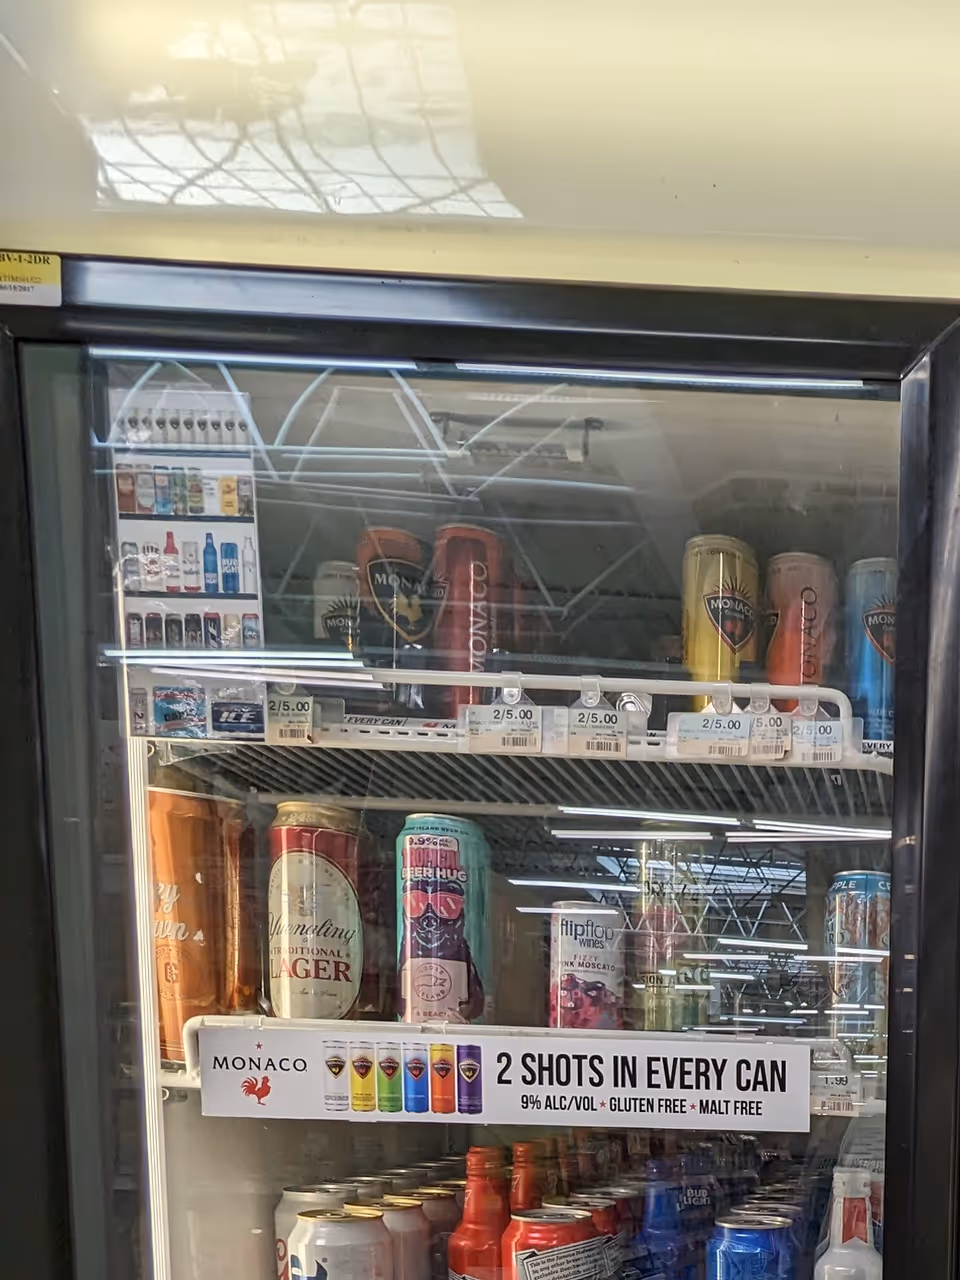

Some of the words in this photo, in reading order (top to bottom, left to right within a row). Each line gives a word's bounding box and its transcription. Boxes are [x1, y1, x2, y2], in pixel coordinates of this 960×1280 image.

[801, 587, 818, 679] ONACO
[269, 700, 310, 712] 2/5.00
[493, 709, 533, 721] 2/5.00
[578, 712, 618, 724] 2/5.00
[702, 718, 741, 730] 2/5.00
[752, 716, 783, 728] /5.00
[793, 724, 832, 736] 2/5.00
[402, 867, 434, 880] BEER
[436, 868, 468, 882] HUG
[271, 957, 352, 983] LAGER
[213, 1056, 307, 1073] MONACO
[497, 1052, 512, 1085] 2
[521, 1052, 604, 1088] SHOTS
[613, 1055, 637, 1089] IN
[646, 1056, 728, 1091] EVERY
[736, 1059, 787, 1093] CAN
[521, 1094, 541, 1110] 9%
[545, 1095, 597, 1112] ALC/VOL
[610, 1097, 654, 1113] GLUTEN
[658, 1098, 687, 1114] FREE
[699, 1100, 730, 1115] MALT
[734, 1100, 763, 1116] FREE
